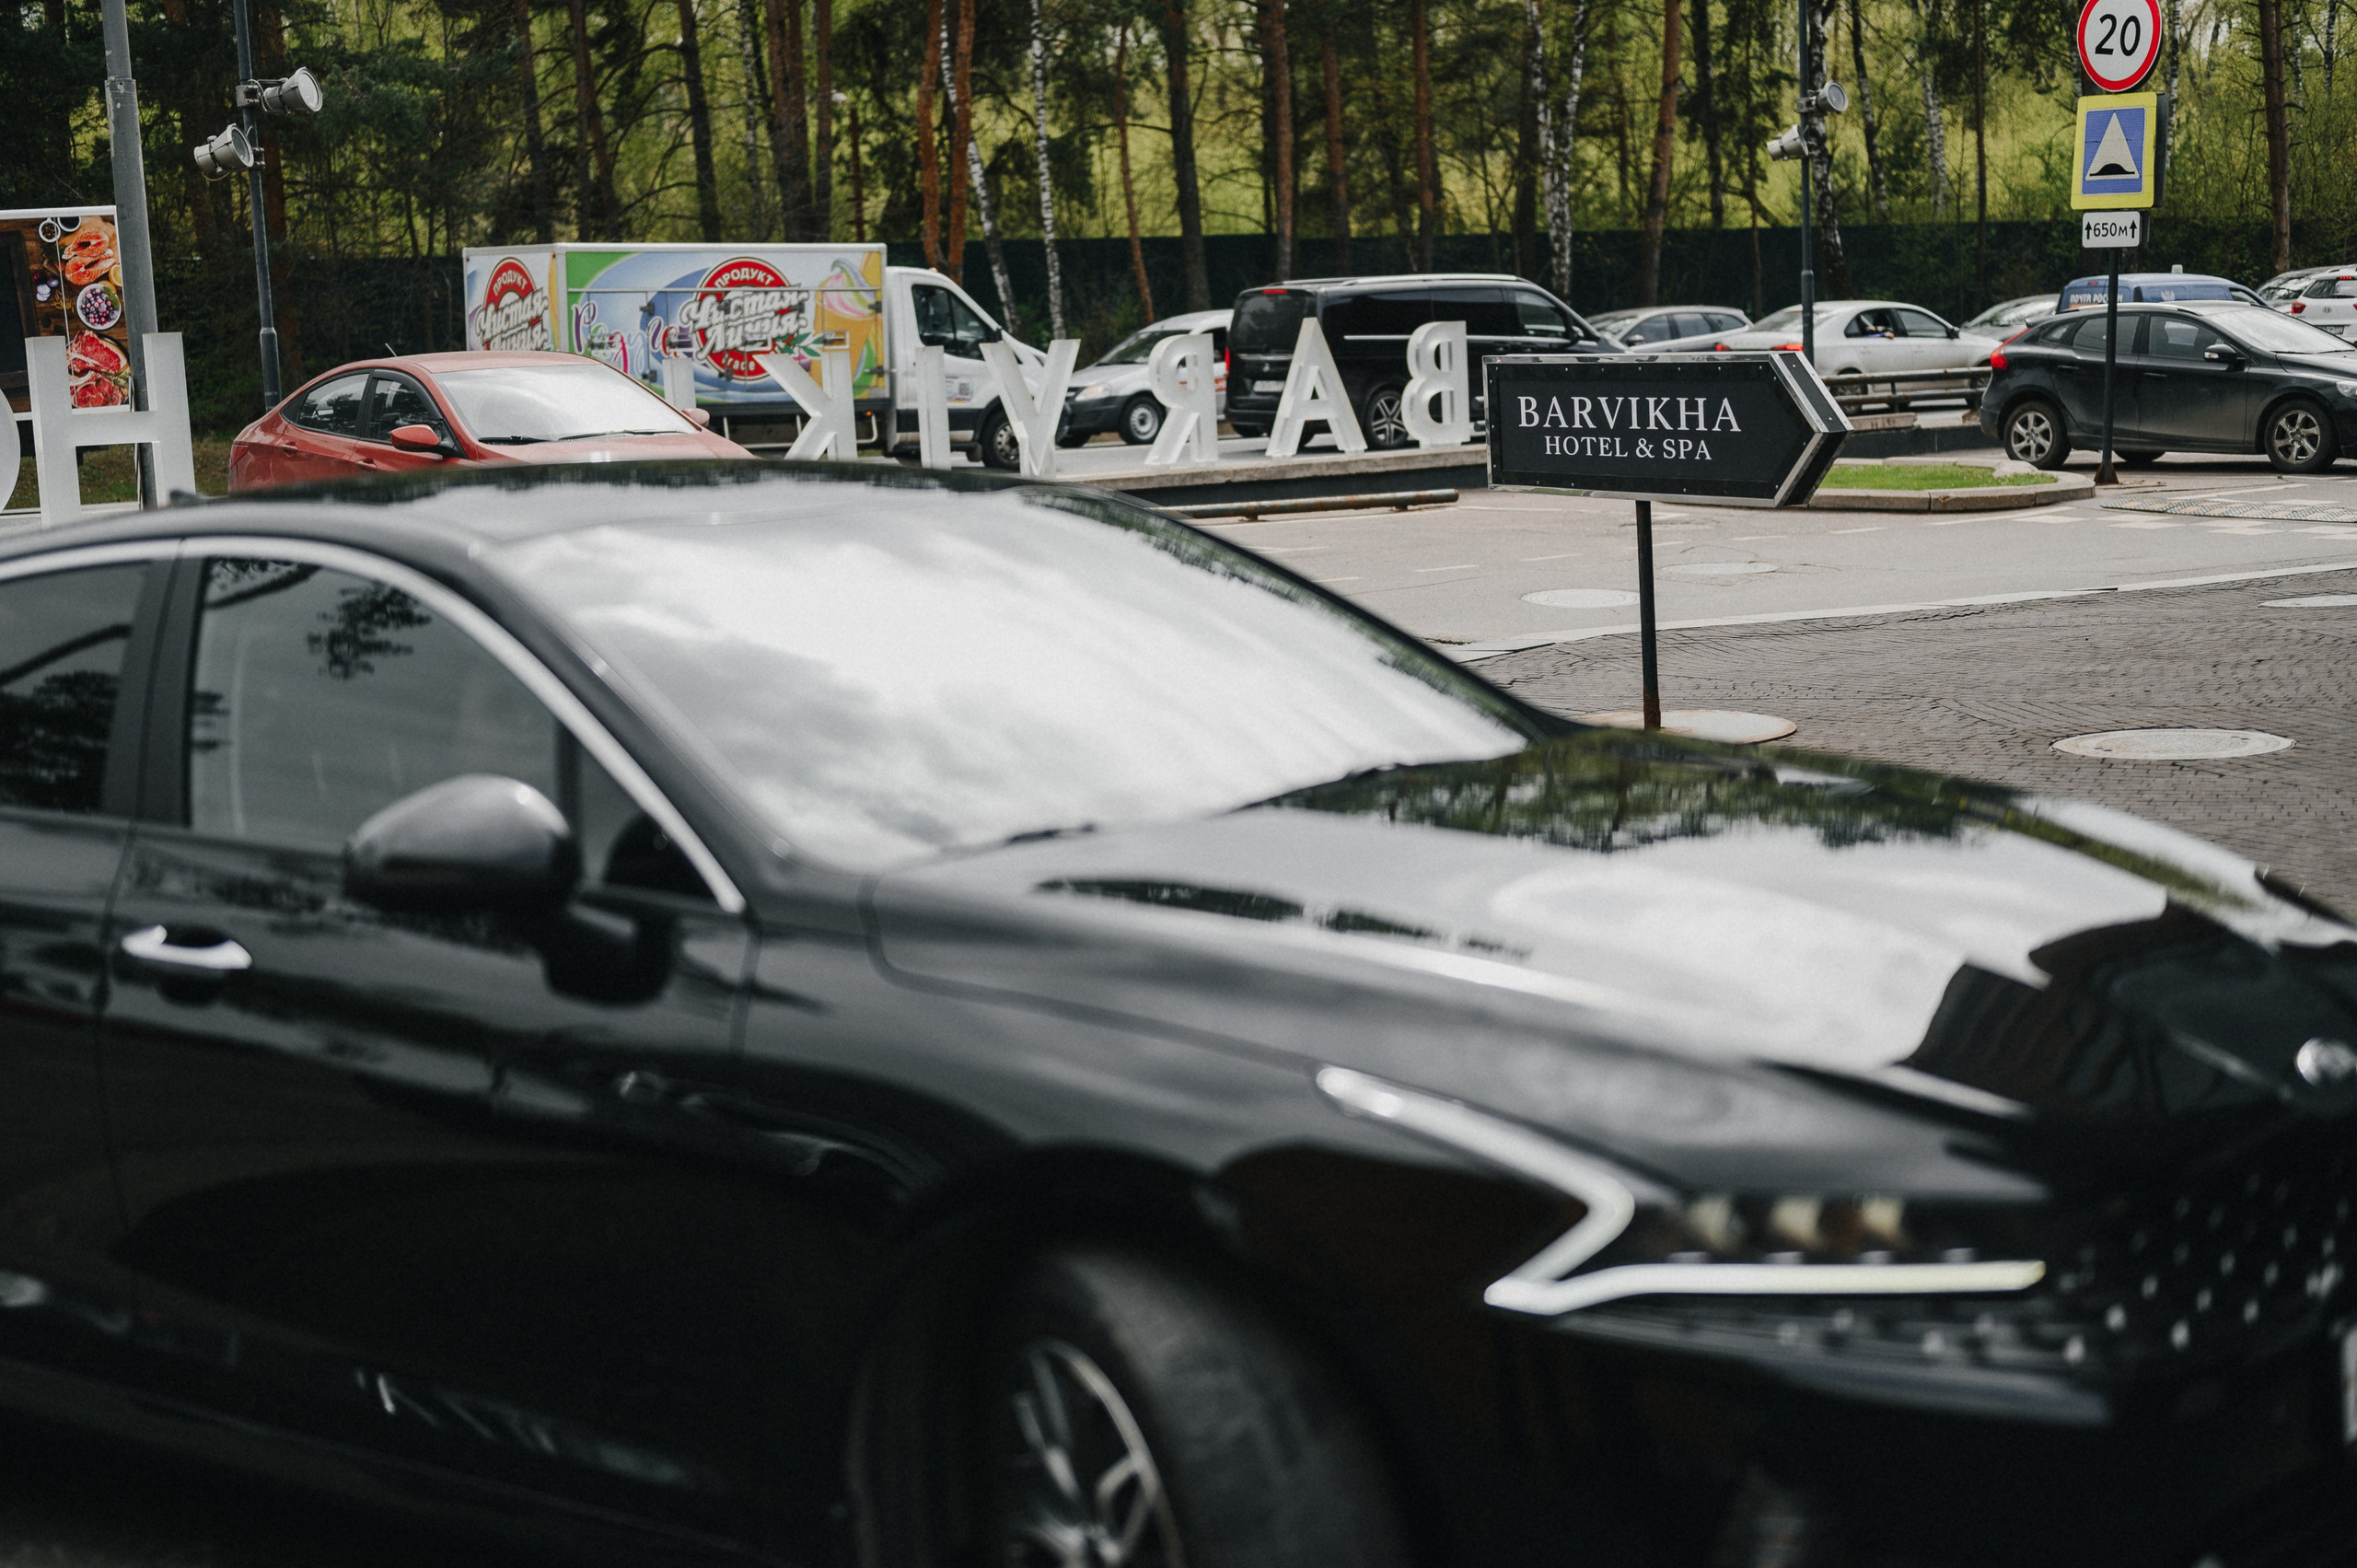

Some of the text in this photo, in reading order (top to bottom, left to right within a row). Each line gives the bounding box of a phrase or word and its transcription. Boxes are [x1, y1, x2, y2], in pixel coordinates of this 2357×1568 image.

[2095, 14, 2142, 57] 20
[493, 270, 528, 296] ПРОДУКТ
[714, 267, 775, 289] ПРОДУКТ
[475, 287, 550, 346] Чистая
[679, 284, 809, 331] Чистая
[695, 309, 808, 360] Линия
[1517, 395, 1741, 432] BARVIKHA
[1544, 436, 1713, 460] HOTEL & SPA
